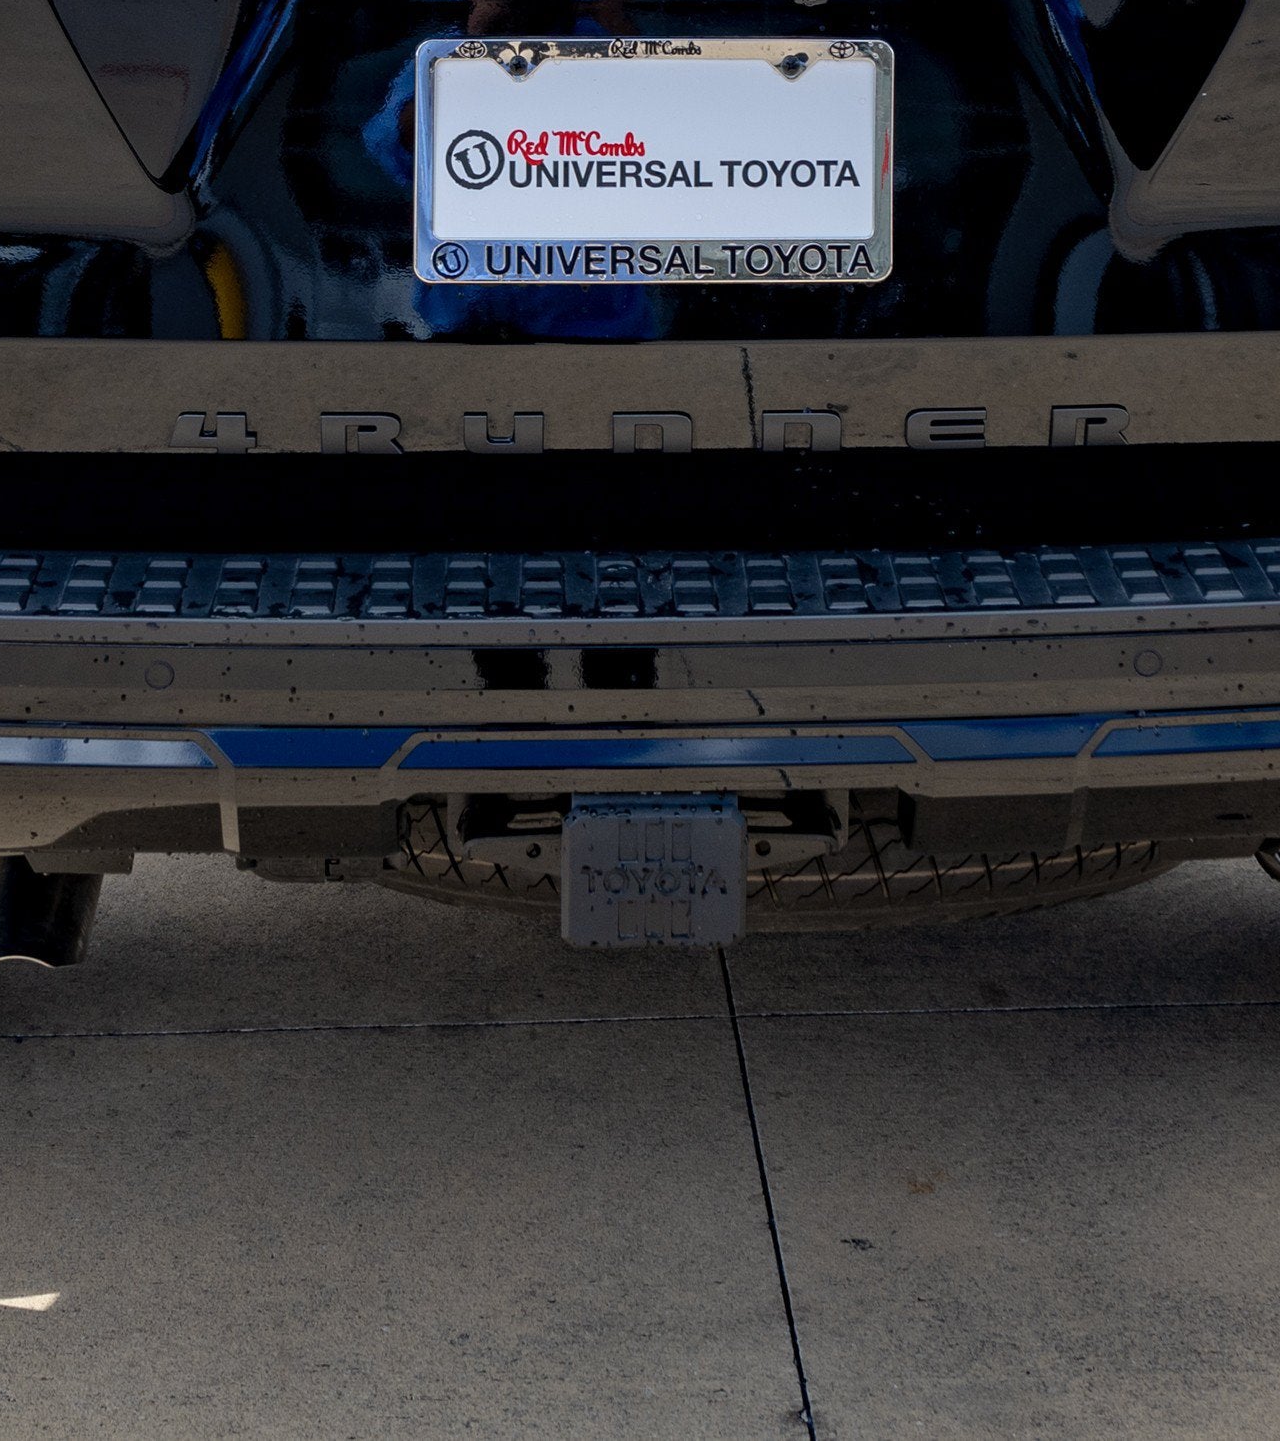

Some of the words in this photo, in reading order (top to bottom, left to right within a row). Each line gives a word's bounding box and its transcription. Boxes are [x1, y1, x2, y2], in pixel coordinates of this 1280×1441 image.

[611, 38, 638, 58] Red
[641, 40, 702, 55] McCombs
[507, 129, 549, 166] Red
[552, 130, 645, 157] McCombs
[509, 160, 713, 188] UNIVERSAL
[720, 160, 860, 188] TOYOTA
[485, 246, 715, 276] UNIVERSAL
[720, 245, 875, 276] TOYOTA
[581, 864, 728, 896] TOYOTA
